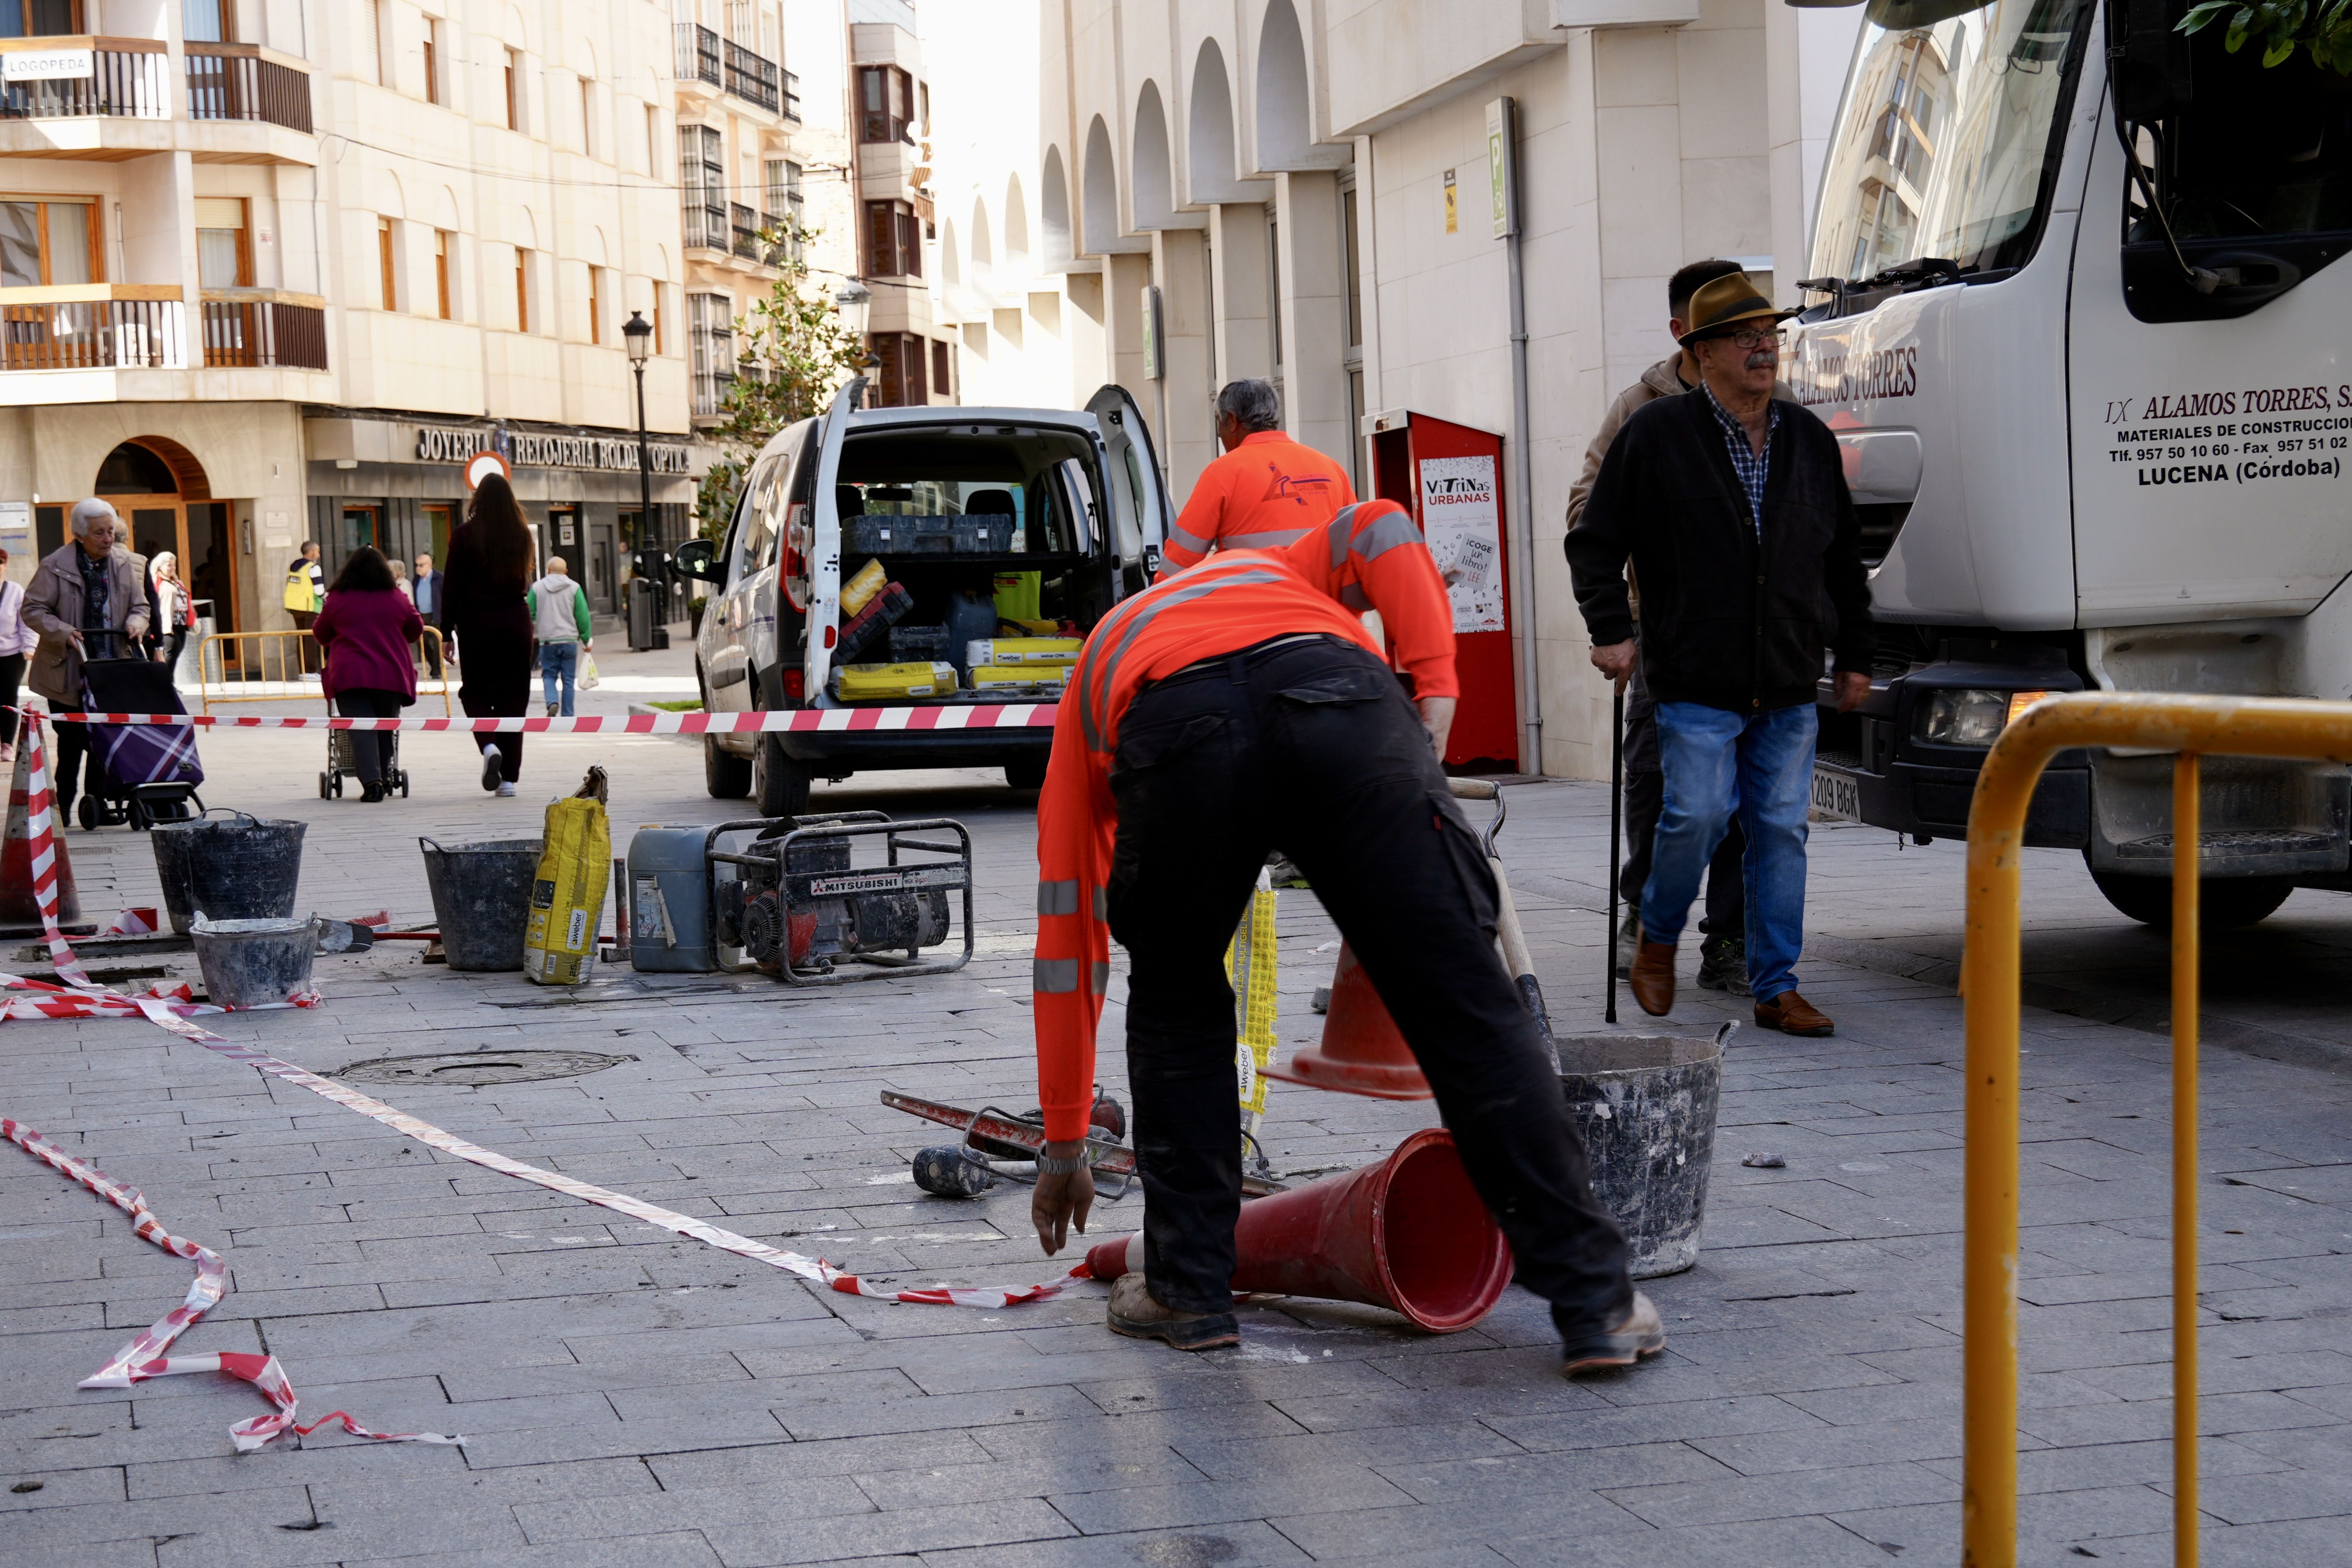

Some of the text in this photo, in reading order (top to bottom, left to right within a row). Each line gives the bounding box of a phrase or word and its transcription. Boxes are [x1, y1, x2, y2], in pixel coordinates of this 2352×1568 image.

[10, 59, 84, 72] LOGOPEDA
[1491, 138, 1500, 180] P
[1799, 353, 1849, 406] ALAMOS
[1854, 346, 1917, 400] TORRES
[2143, 392, 2236, 419] ALAMOS
[2243, 386, 2330, 413] TORRES,
[2118, 417, 2352, 442] MATERIALES DE CONSTRUCCIO
[420, 430, 490, 461] JOYERIA
[515, 436, 595, 468] RELOJERIA
[651, 446, 690, 473] OPTICA
[2109, 450, 2132, 462] Tlf.
[2137, 448, 2162, 460] 957
[2168, 447, 2185, 459] 50
[2190, 445, 2207, 457] 10
[2212, 444, 2229, 456] 60
[2277, 439, 2303, 452] 957
[2308, 438, 2323, 450] 51
[2330, 436, 2347, 448] 02
[2139, 457, 2340, 486] LUCENA (Córdoba)
[1429, 493, 1490, 505] URBANAS
[1466, 539, 1493, 554] ¡COGE
[1462, 555, 1487, 572] libro!
[1468, 571, 1481, 583] LEE
[1836, 780, 1857, 818] BGK
[825, 878, 898, 892] MITSUBISHI
[1238, 924, 1247, 966] MULTIGEL
[570, 965, 577, 977] 25
[1240, 1047, 1249, 1085] weber
